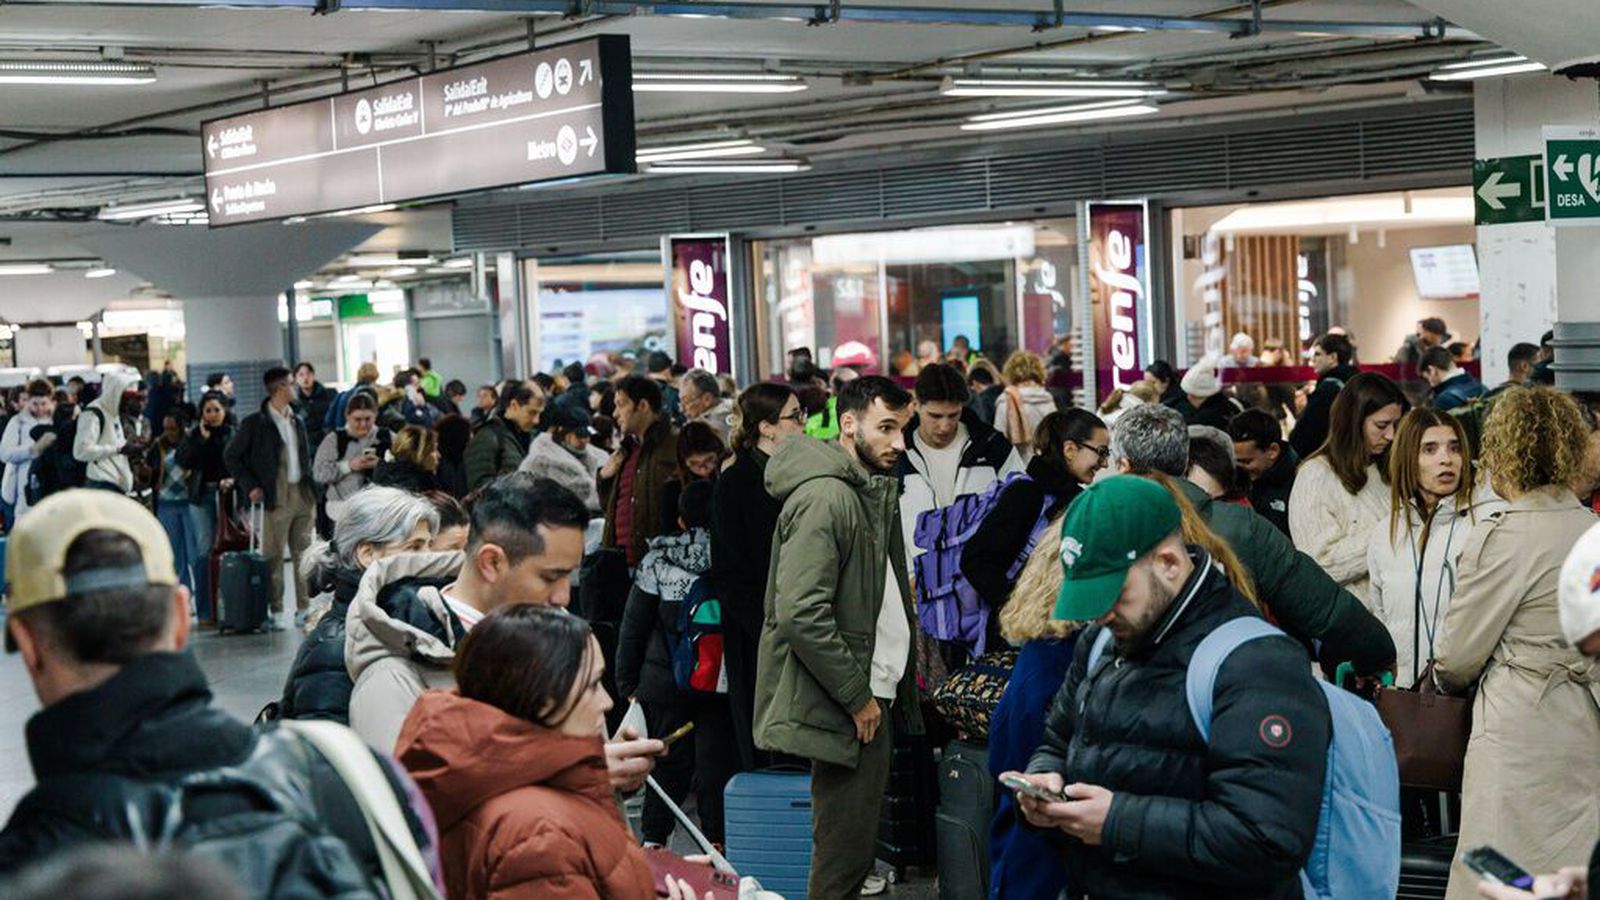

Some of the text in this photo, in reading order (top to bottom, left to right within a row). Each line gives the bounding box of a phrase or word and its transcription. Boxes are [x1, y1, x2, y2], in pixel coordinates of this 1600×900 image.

[1557, 194, 1586, 207] DESA
[678, 259, 727, 375] enfe
[1095, 229, 1145, 391] renfe
